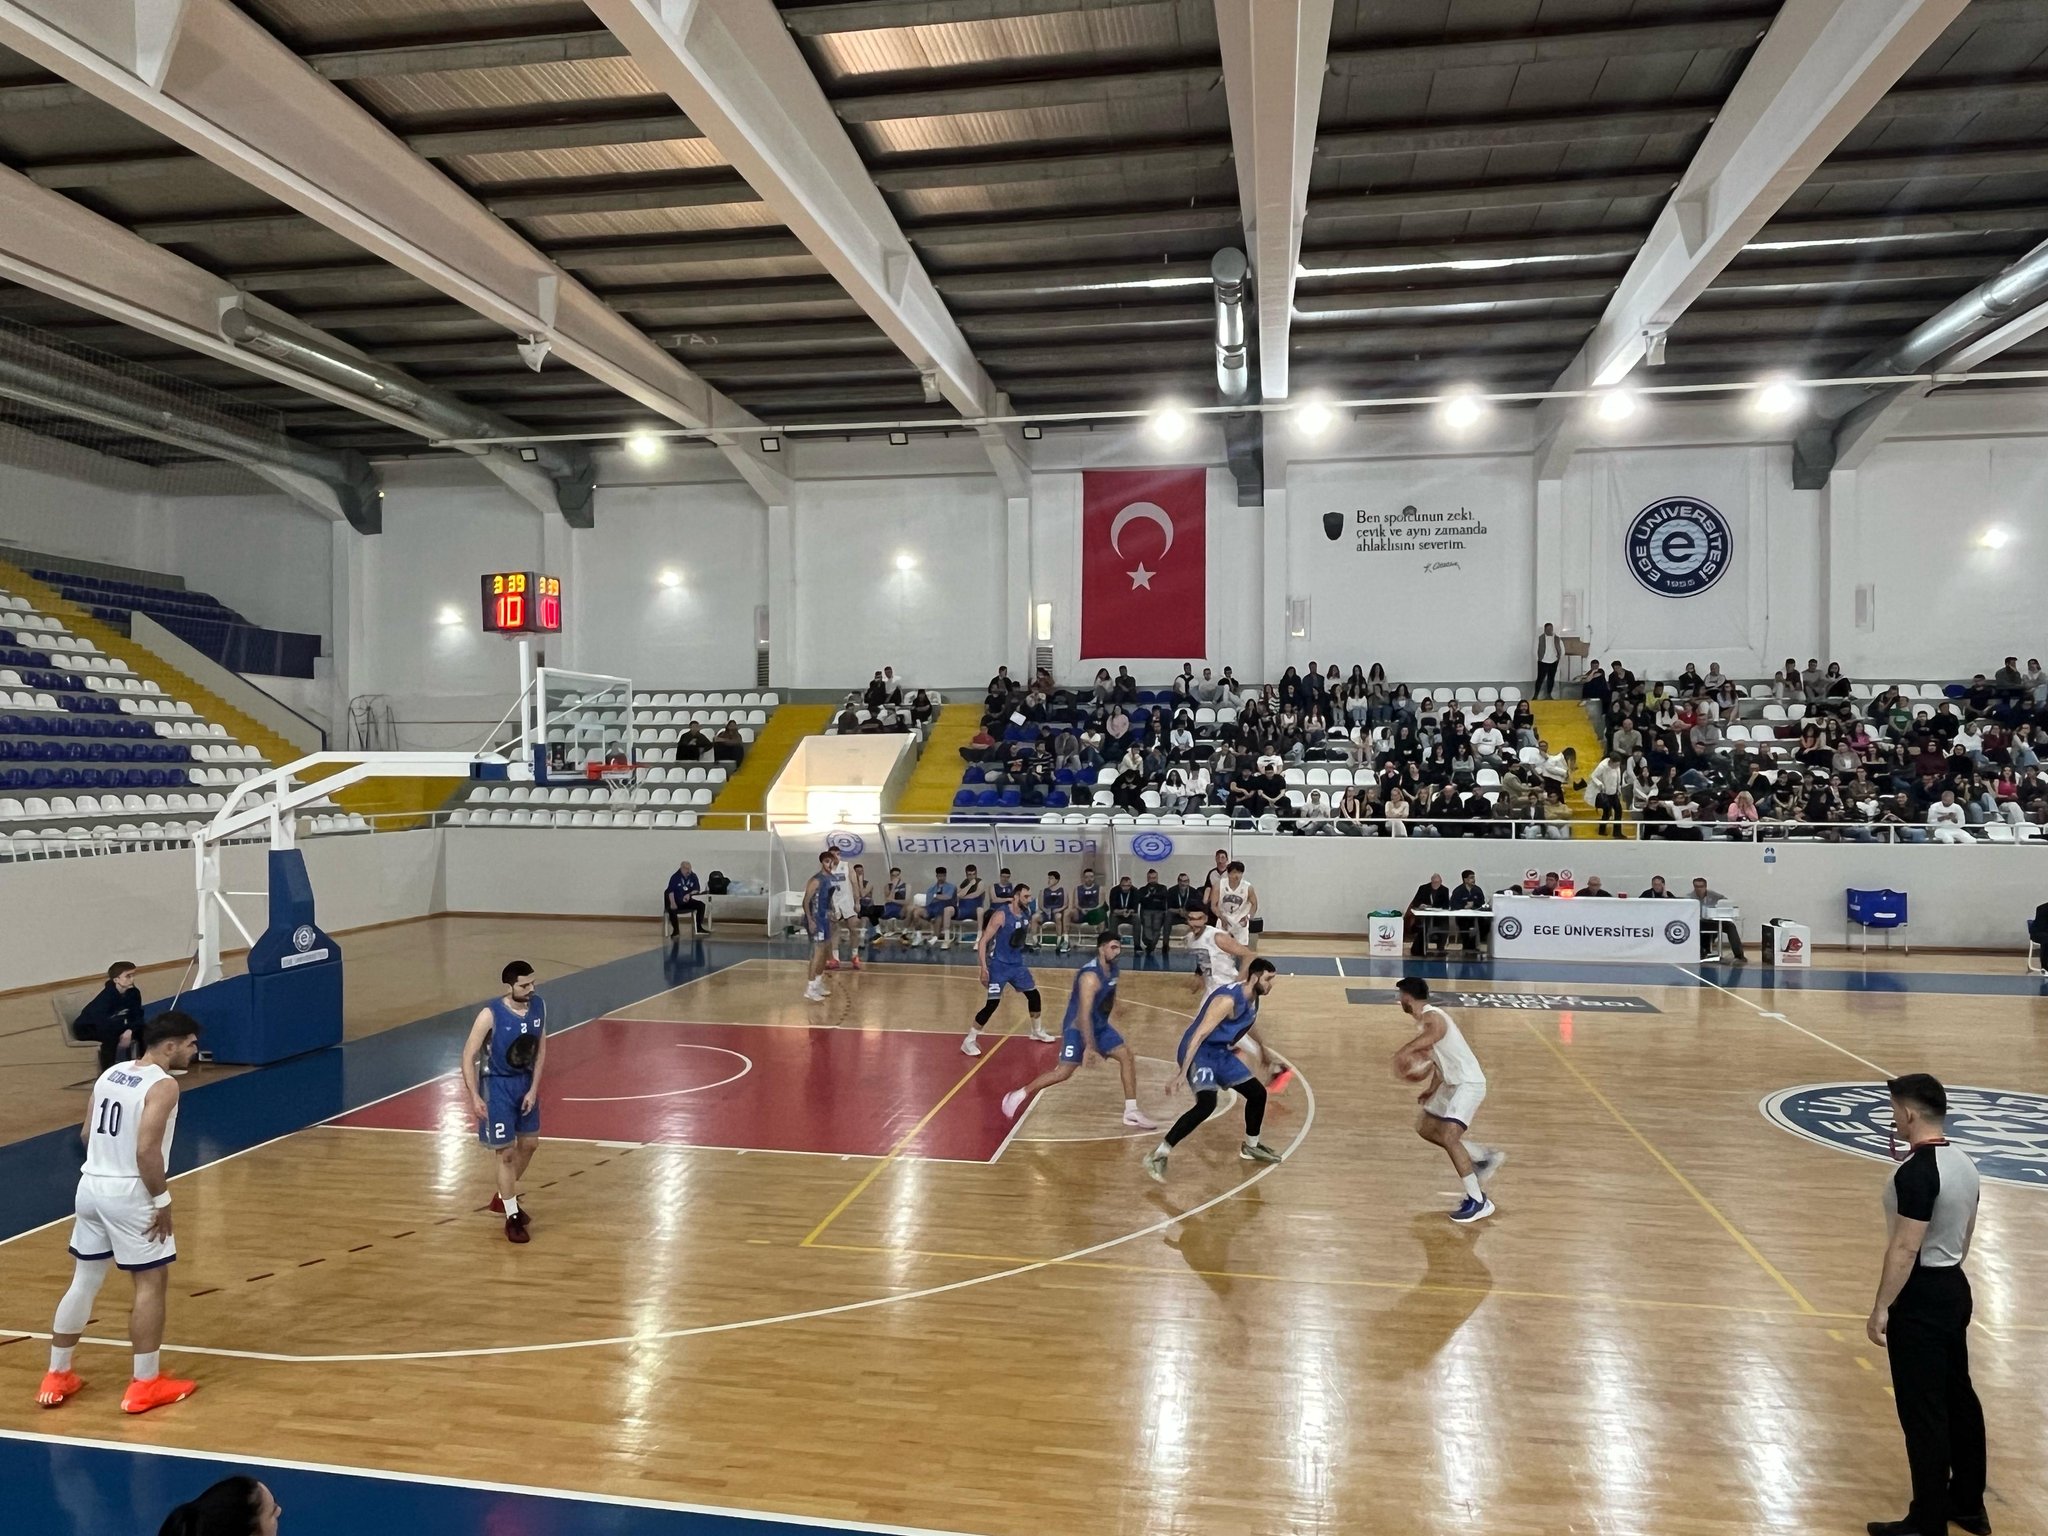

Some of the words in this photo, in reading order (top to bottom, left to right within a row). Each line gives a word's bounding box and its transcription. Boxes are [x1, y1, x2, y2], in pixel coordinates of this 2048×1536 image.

[1356, 509, 1380, 523] Ben
[1390, 528, 1402, 536] ve
[1406, 528, 1431, 539] aynı
[1434, 521, 1487, 535] zamanda
[1356, 538, 1415, 552] ahlaklısını
[1635, 506, 1722, 582] ÜNİVERSİTESİ
[1636, 545, 1661, 582] EGE
[497, 595, 524, 628] 10
[1533, 925, 1560, 935] EGE
[1564, 924, 1654, 938] ÜNİVERSİTESİ
[1065, 1046, 1074, 1057] 6
[97, 1098, 122, 1137] 10
[494, 1122, 506, 1139] 2
